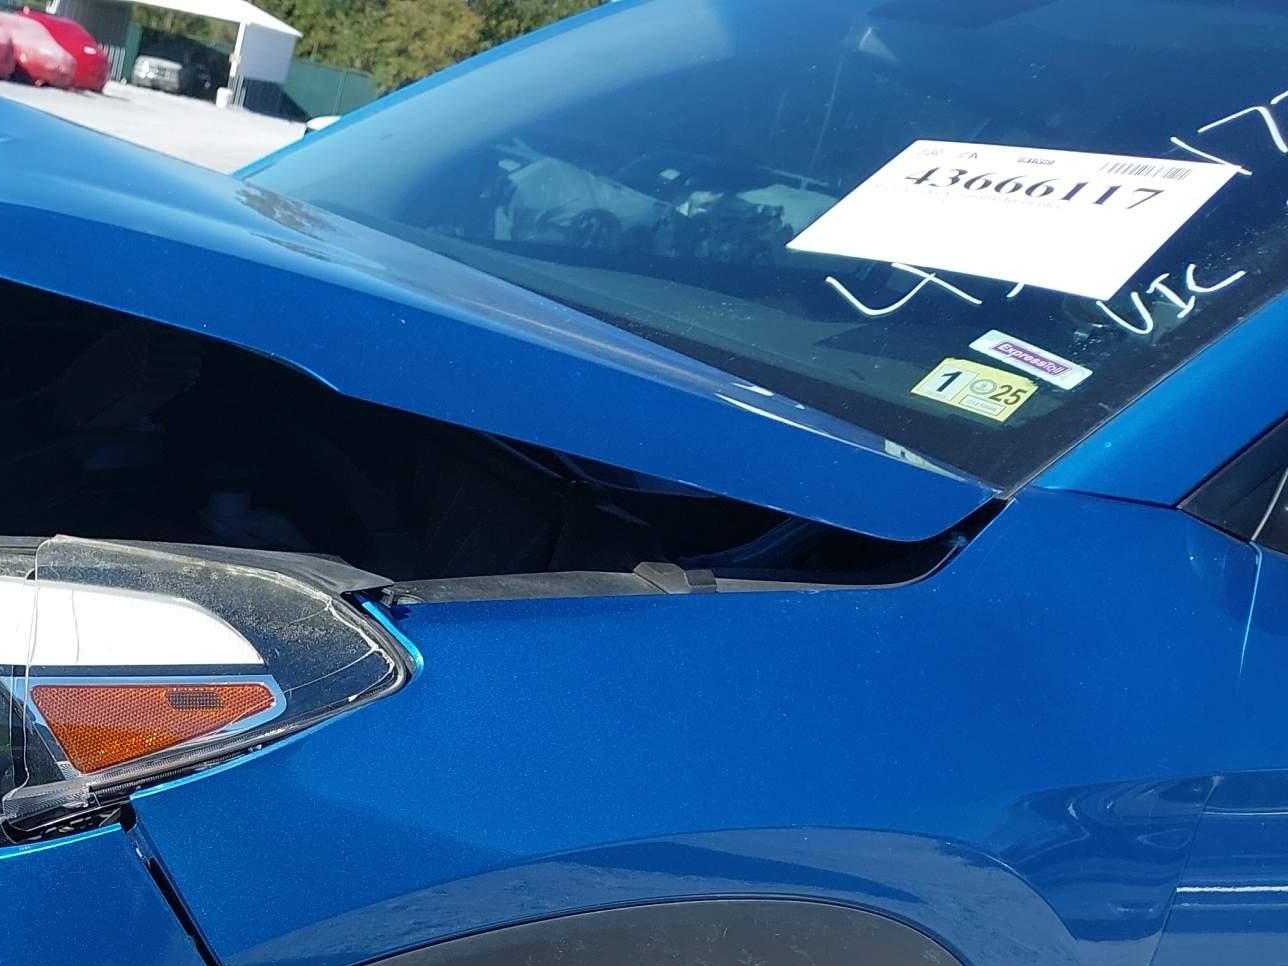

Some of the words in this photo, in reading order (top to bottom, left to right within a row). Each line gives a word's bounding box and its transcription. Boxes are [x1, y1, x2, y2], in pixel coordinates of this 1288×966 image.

[904, 166, 1164, 209] 43666117
[937, 371, 963, 392] 1
[988, 384, 1028, 406] 25
